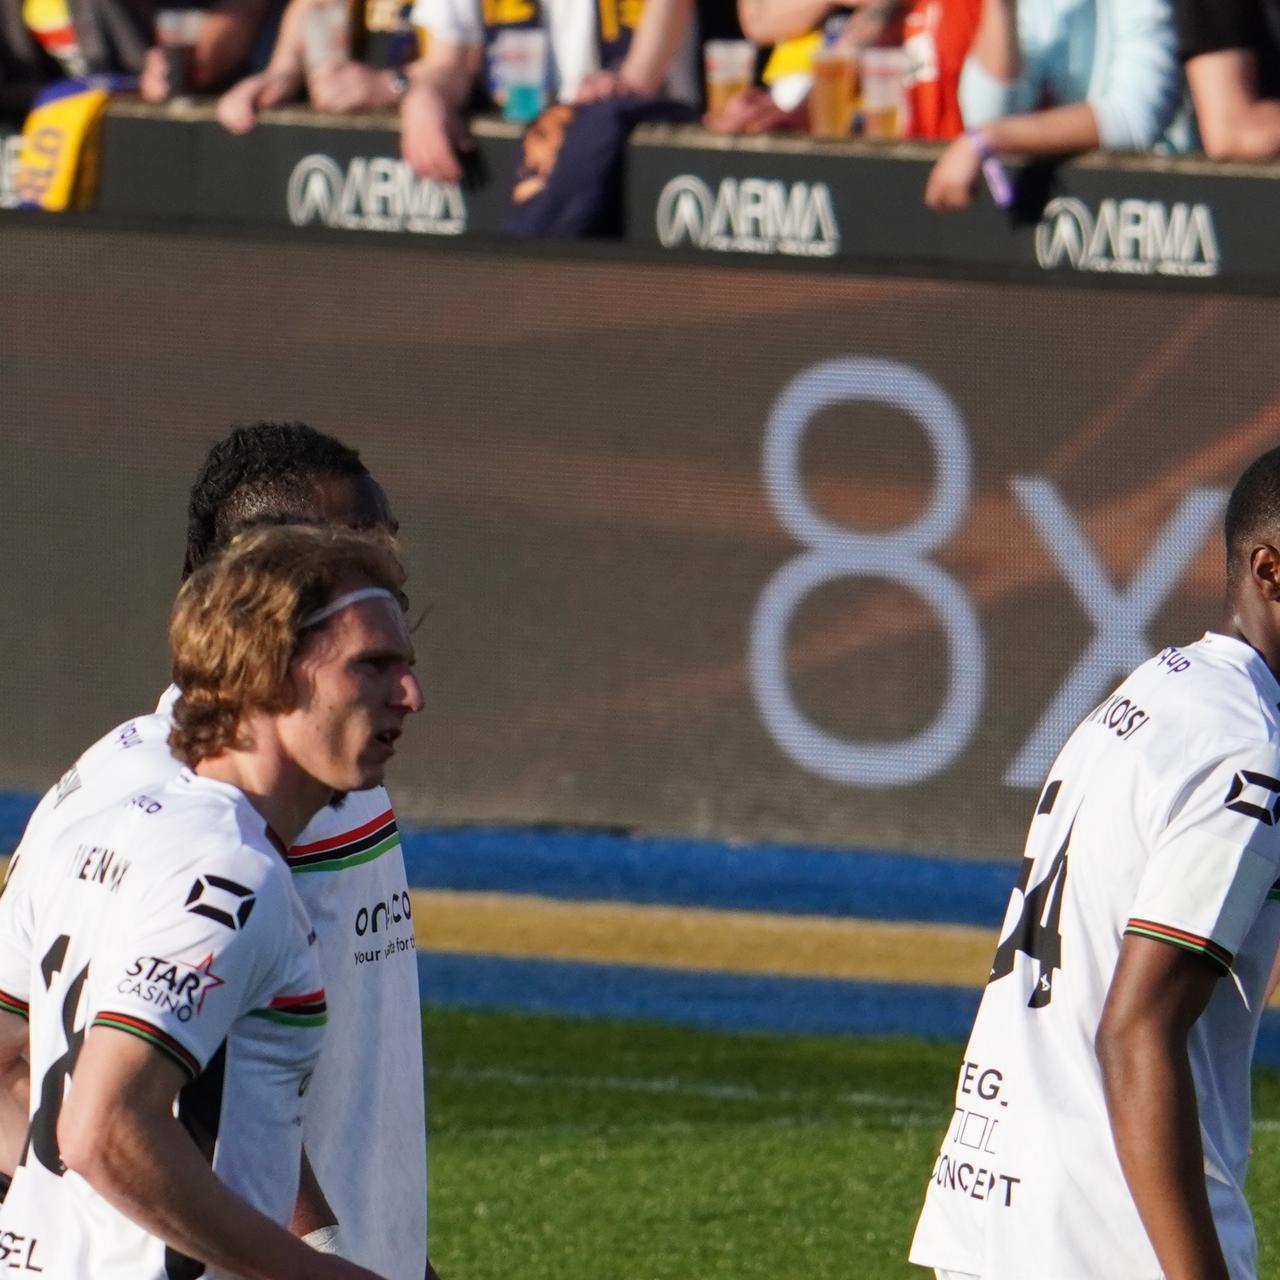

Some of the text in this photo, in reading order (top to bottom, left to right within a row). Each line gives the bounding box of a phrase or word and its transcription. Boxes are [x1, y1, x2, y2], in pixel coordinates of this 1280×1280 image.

[1087, 199, 1218, 263] ARMA
[353, 949, 381, 966] Your
[396, 936, 409, 953] for
[117, 978, 192, 1023] CASINO
[126, 956, 201, 1005] STAR
